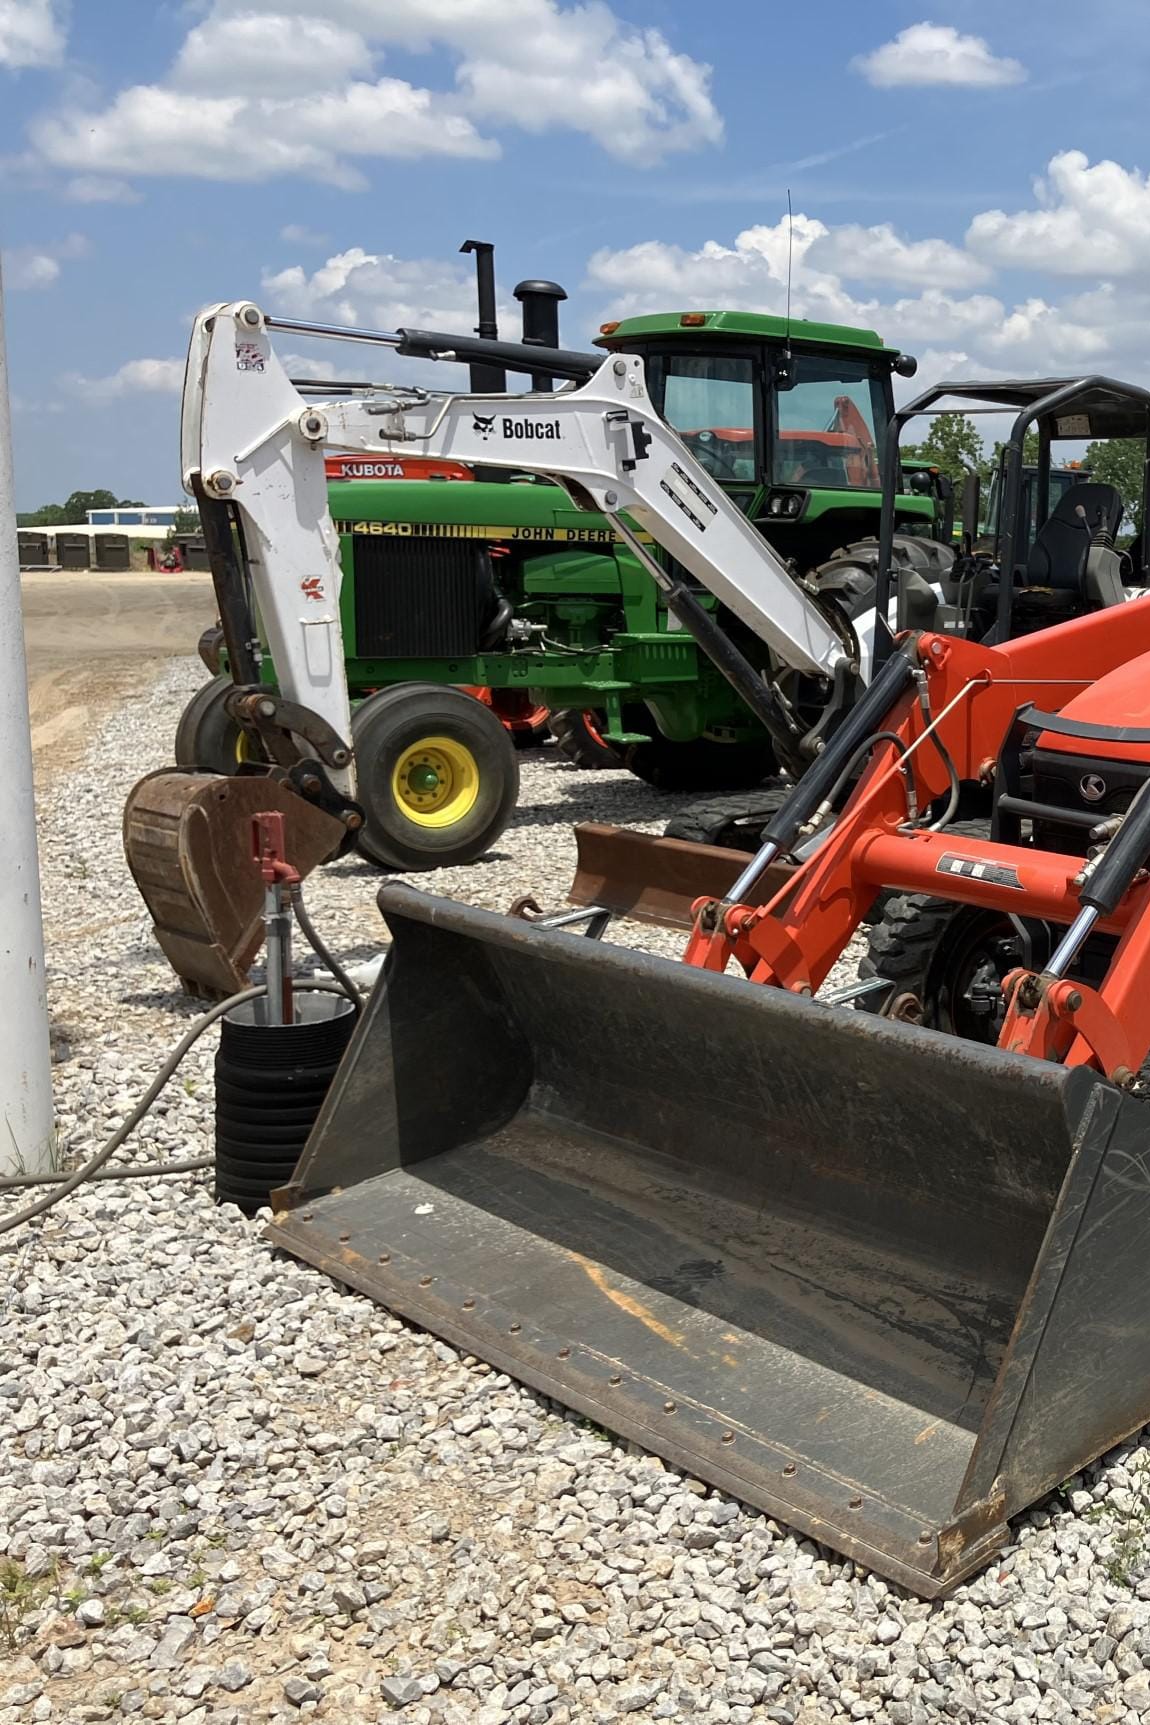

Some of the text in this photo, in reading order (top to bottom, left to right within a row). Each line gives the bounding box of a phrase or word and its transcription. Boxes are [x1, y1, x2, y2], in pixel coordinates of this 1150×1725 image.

[502, 418, 561, 440] Bobcat
[341, 464, 404, 477] KUBOTA
[354, 522, 412, 536] 4640
[512, 528, 616, 542] JOHN DEERE
